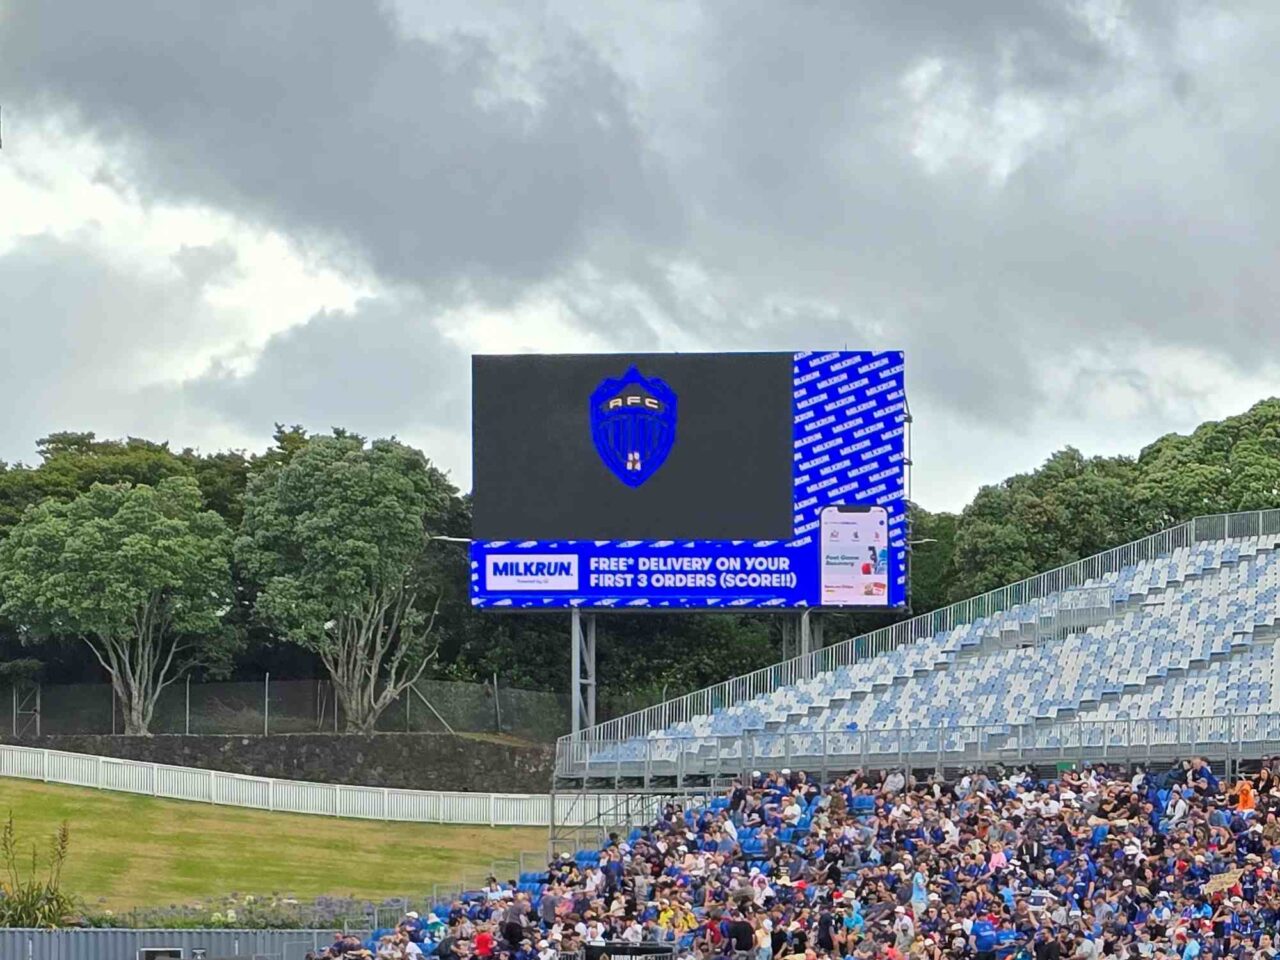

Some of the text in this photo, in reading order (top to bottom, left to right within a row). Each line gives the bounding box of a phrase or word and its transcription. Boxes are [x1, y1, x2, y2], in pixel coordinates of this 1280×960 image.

[609, 396, 659, 409] AFC
[638, 557, 712, 571] DELIVERY
[716, 557, 740, 571] ON
[744, 557, 790, 571] YOUR
[590, 574, 634, 588] FIRST
[637, 574, 648, 588] 3
[651, 573, 717, 588] ORDERS
